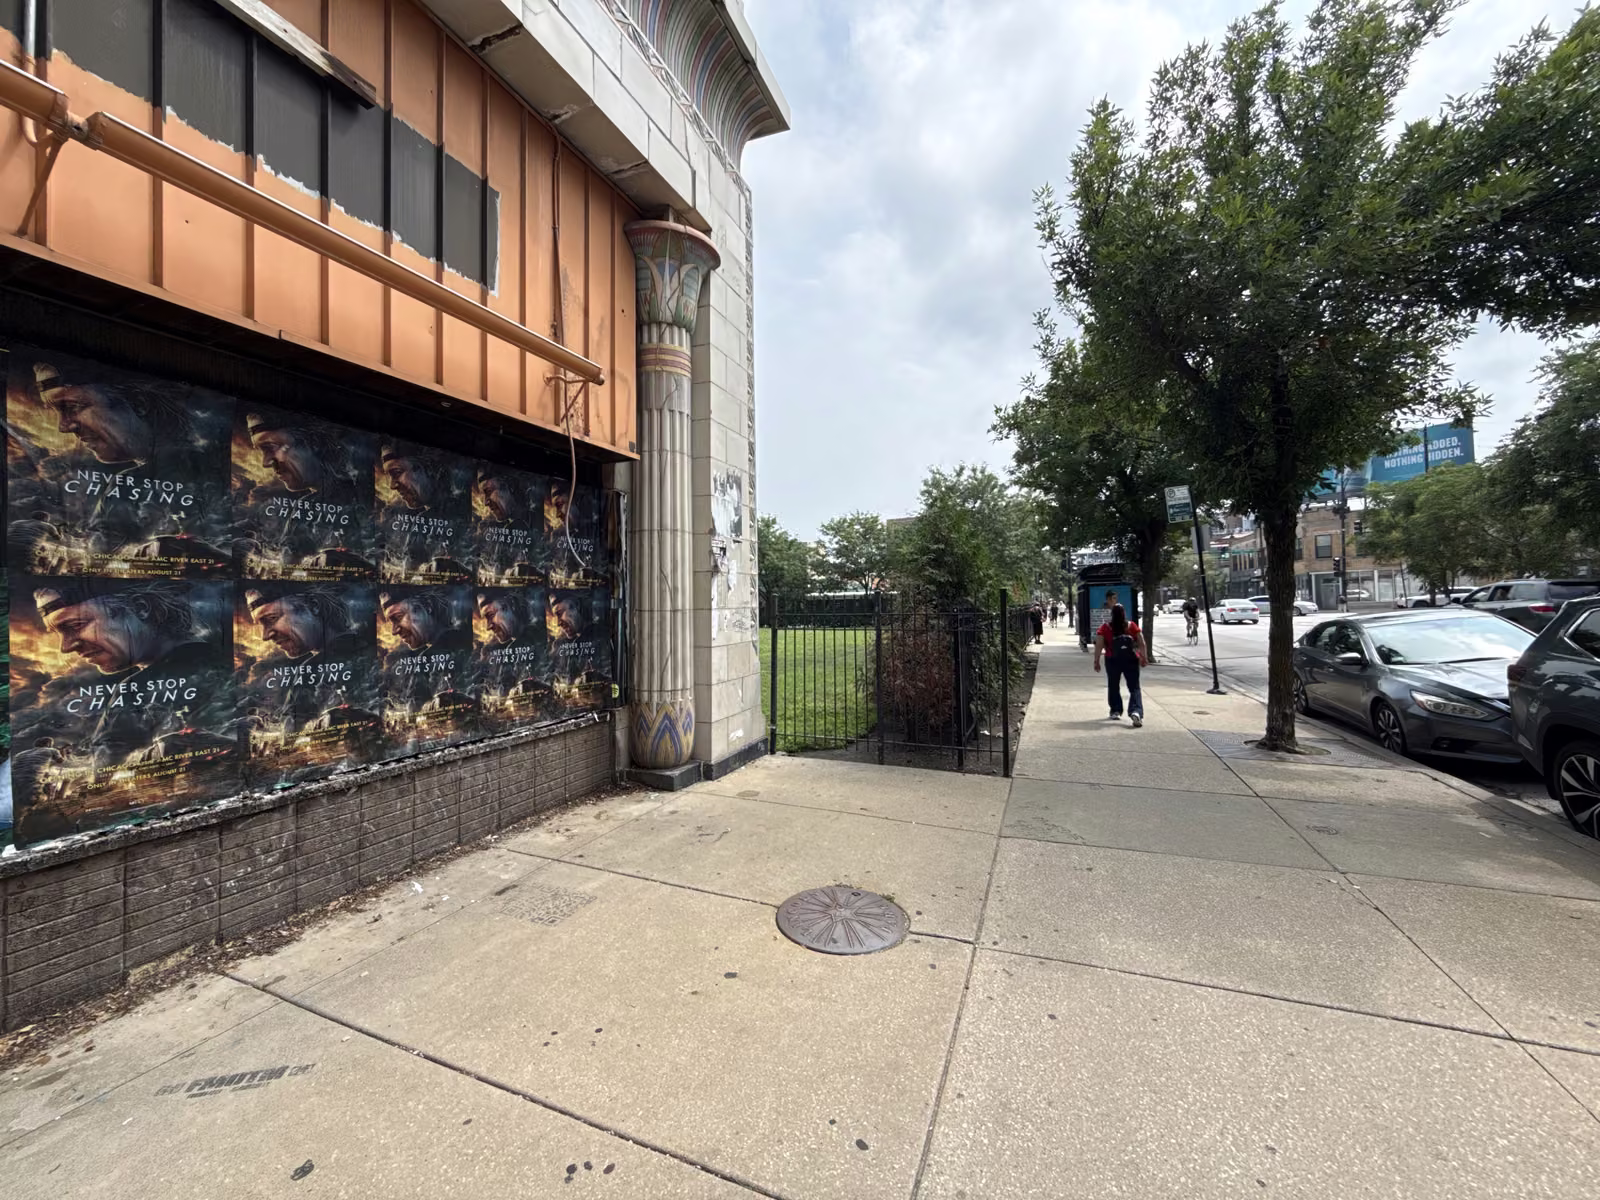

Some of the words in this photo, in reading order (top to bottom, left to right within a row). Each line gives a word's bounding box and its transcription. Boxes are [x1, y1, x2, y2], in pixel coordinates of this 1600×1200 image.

[1384, 453, 1424, 469] NOTHING
[77, 470, 135, 486] NEVER
[144, 478, 184, 492] STOP
[64, 480, 194, 506] CHASING
[272, 496, 310, 510] NEVER
[315, 502, 342, 512] STOP
[265, 506, 349, 524] CHASING
[397, 514, 424, 524] NEVER
[428, 518, 448, 526] STOP
[392, 521, 453, 536] CHASING
[486, 532, 532, 544] CHASING
[489, 652, 534, 664] CHASING
[514, 646, 530, 654] STOP
[400, 656, 427, 665] NEVER
[430, 654, 450, 662] STOP
[274, 665, 312, 676] NEVER
[318, 662, 344, 672] STOP
[395, 660, 454, 676] CHASING
[266, 670, 352, 688] CHASING
[80, 682, 138, 697] NEVER
[146, 678, 186, 691] STOP
[66, 688, 197, 712] CHASING
[96, 762, 136, 774] CHICAGO
[174, 752, 192, 760] RIVER
[195, 748, 210, 756] EAST
[87, 782, 106, 790] ONLY
[153, 768, 177, 777] AUGUST
